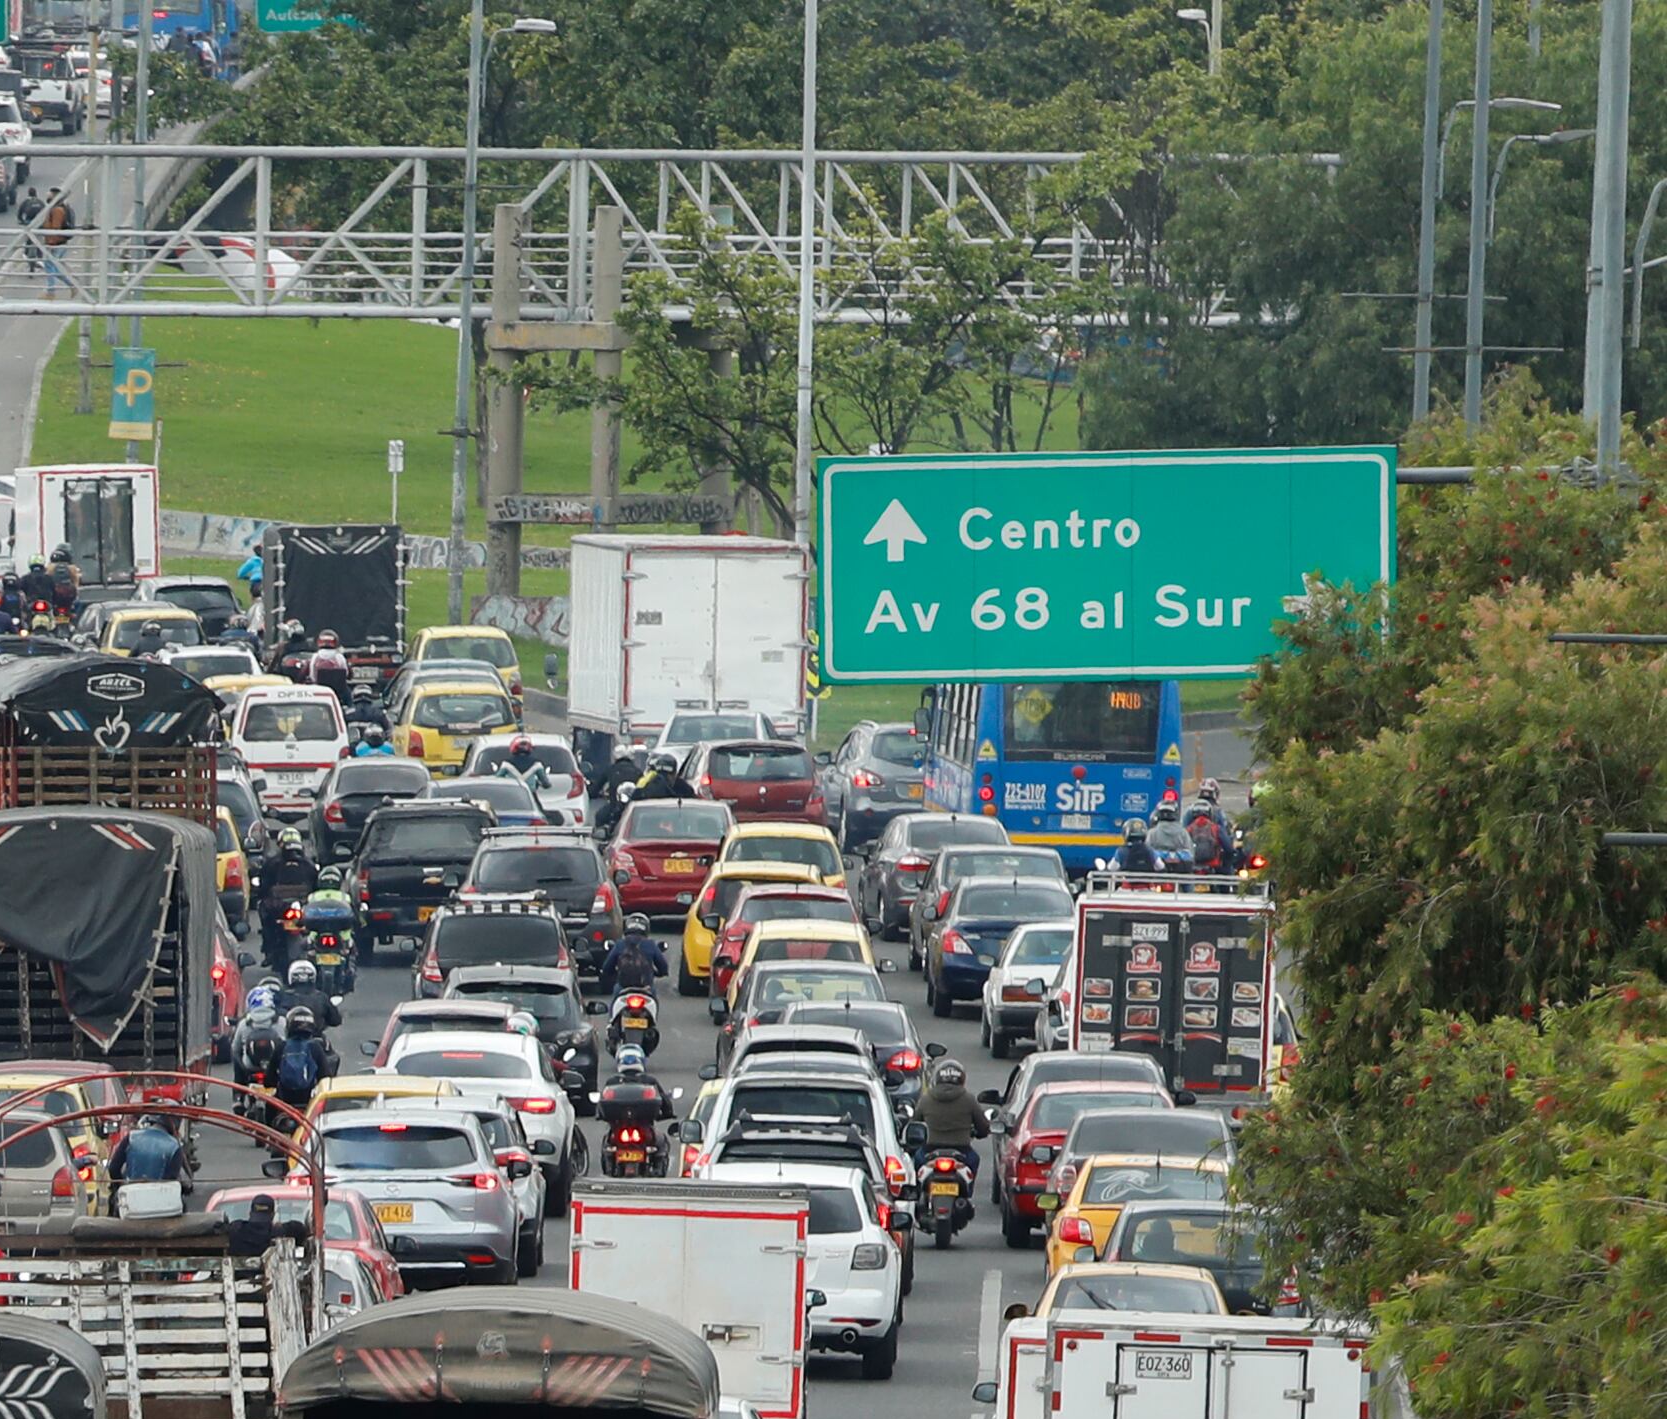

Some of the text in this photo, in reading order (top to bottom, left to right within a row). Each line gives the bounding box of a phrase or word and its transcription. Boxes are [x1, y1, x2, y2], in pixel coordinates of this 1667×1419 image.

[958, 507, 1142, 552] Centro
[865, 585, 1252, 634] Av 68 al Sur
